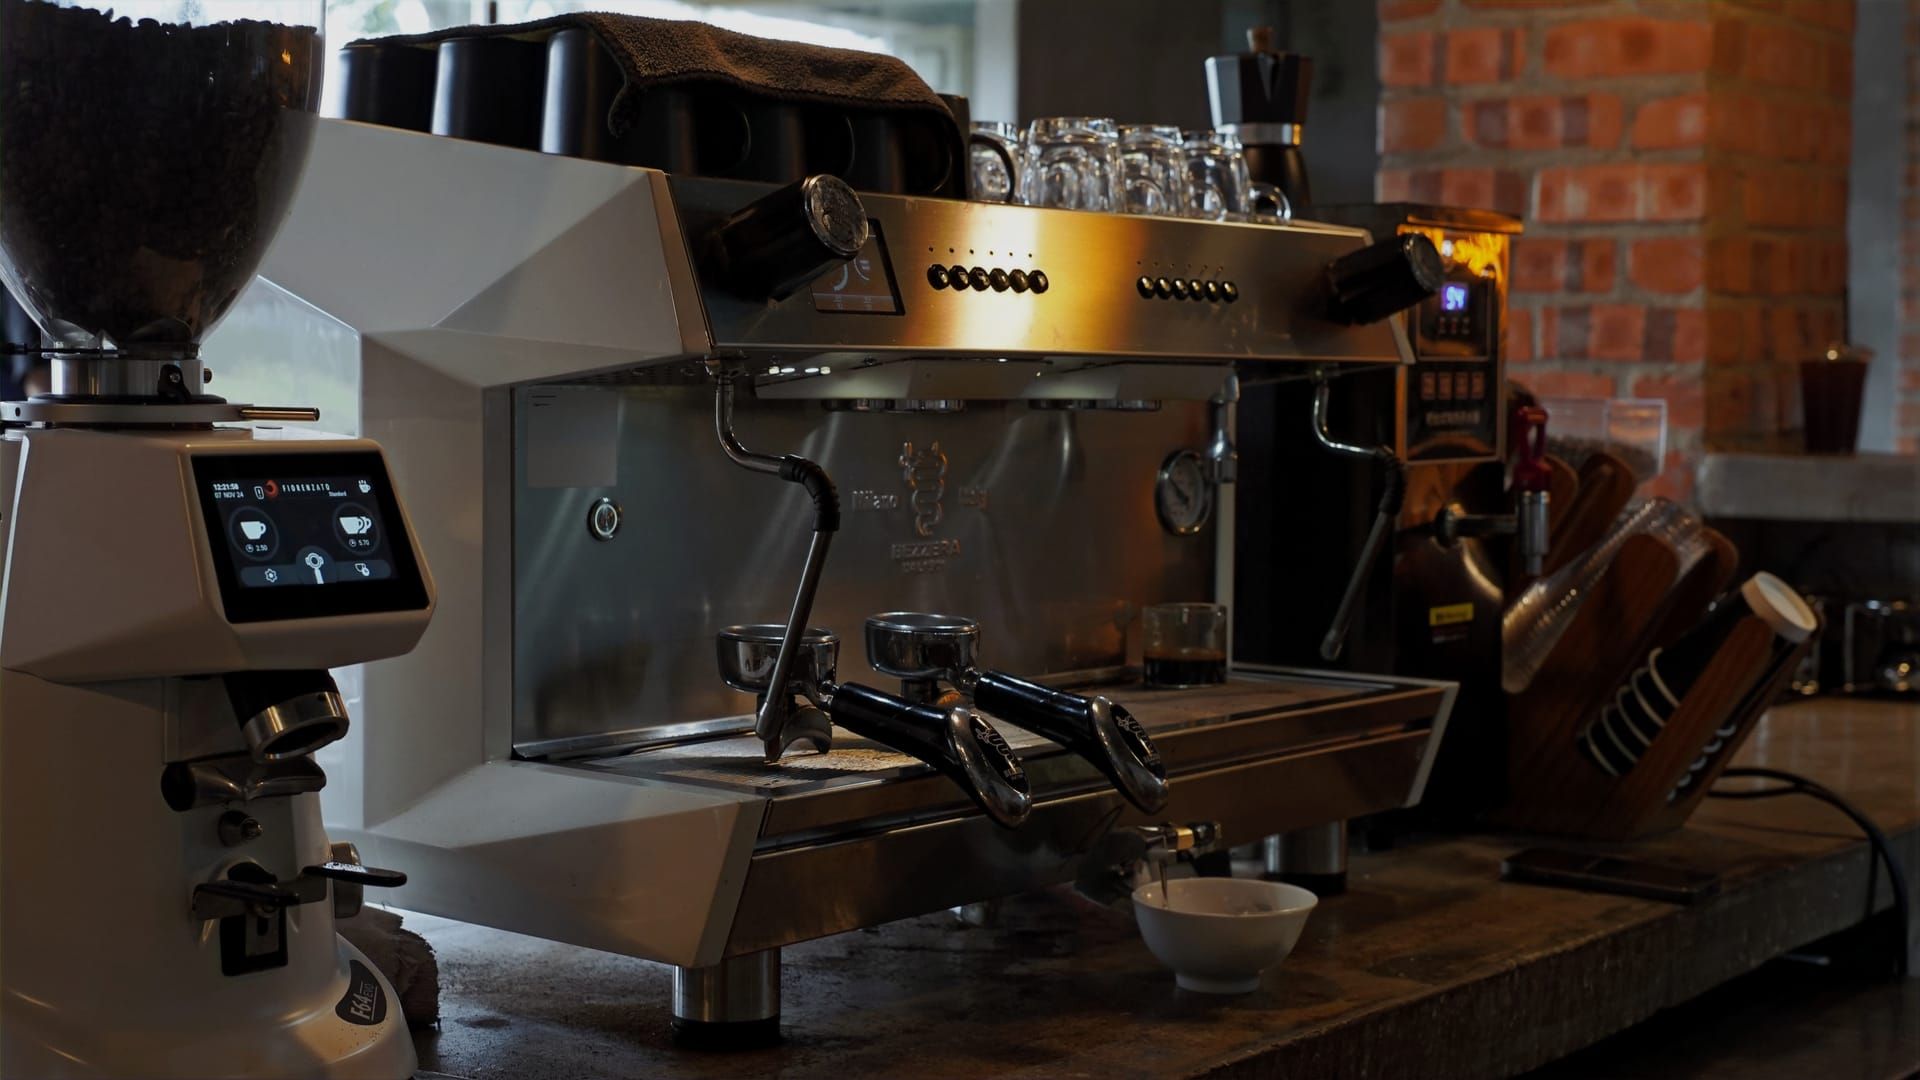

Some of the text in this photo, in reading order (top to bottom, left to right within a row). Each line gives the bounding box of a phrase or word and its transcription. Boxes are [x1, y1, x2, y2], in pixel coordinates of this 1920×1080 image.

[282, 483, 330, 492] FIORENZATO
[223, 491, 236, 499] NOV
[891, 540, 960, 559] BEZZERA
[351, 993, 372, 1020] F64
